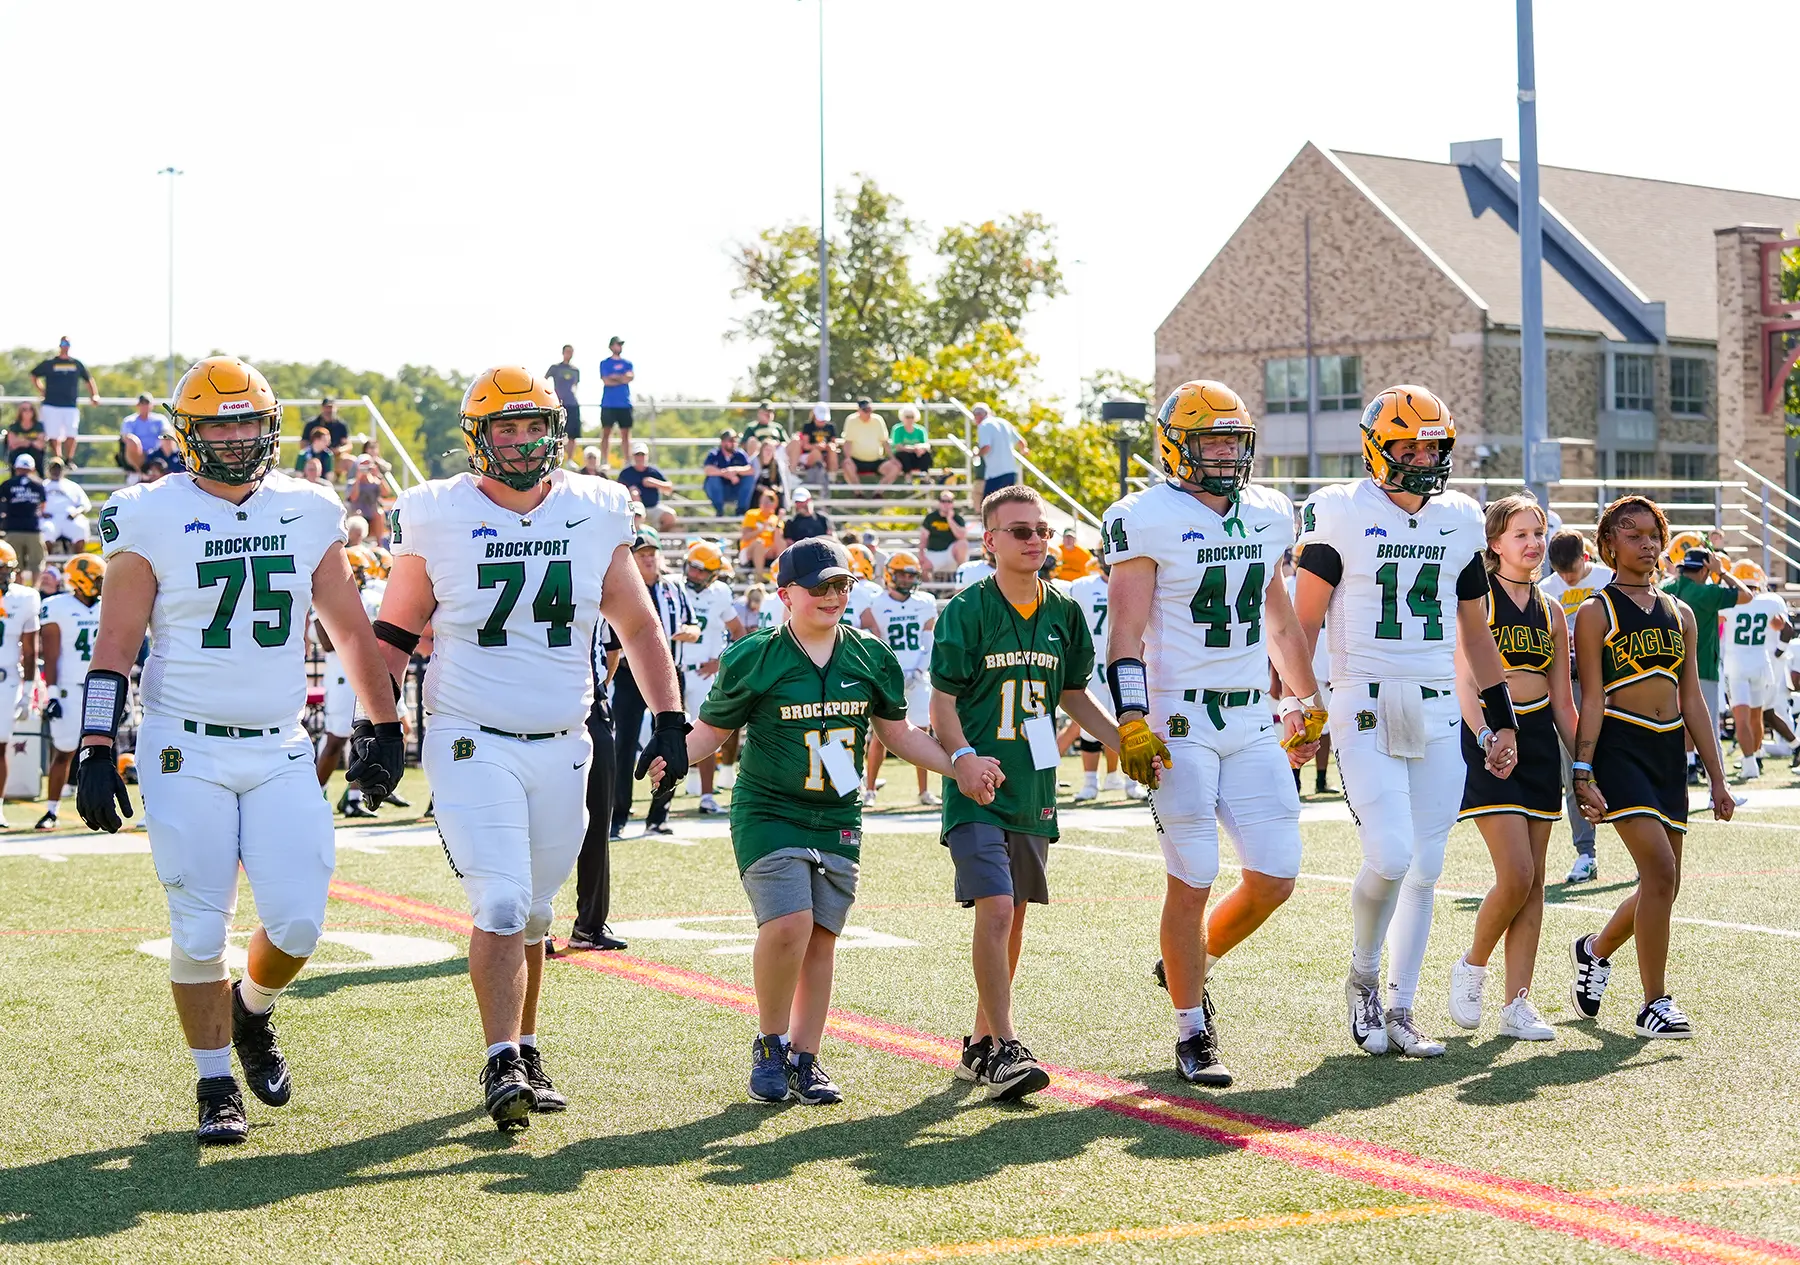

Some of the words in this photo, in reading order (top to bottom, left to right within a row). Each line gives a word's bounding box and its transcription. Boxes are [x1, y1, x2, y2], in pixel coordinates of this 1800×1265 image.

[98, 506, 119, 544] 5
[389, 508, 402, 544] 4
[1299, 503, 1316, 534] 4
[204, 534, 287, 558] BROCKPORT
[485, 539, 570, 558] BROCKPORT
[1197, 544, 1262, 564] BROCKPORT
[1376, 543, 1446, 560] BROCKPORT
[196, 555, 296, 649] 75
[477, 560, 577, 648] 74
[1189, 562, 1265, 648] 44
[1374, 562, 1443, 640] 14
[888, 622, 920, 651] 26
[1491, 626, 1554, 658] AGLE
[1734, 613, 1768, 646] 22
[985, 651, 1059, 671] BROCKPORT
[780, 701, 868, 720] BROCKPORT
[996, 680, 1046, 741] 15
[1166, 713, 1191, 737] B
[1355, 710, 1377, 731] B
[160, 746, 184, 774] B
[452, 736, 476, 761] B
